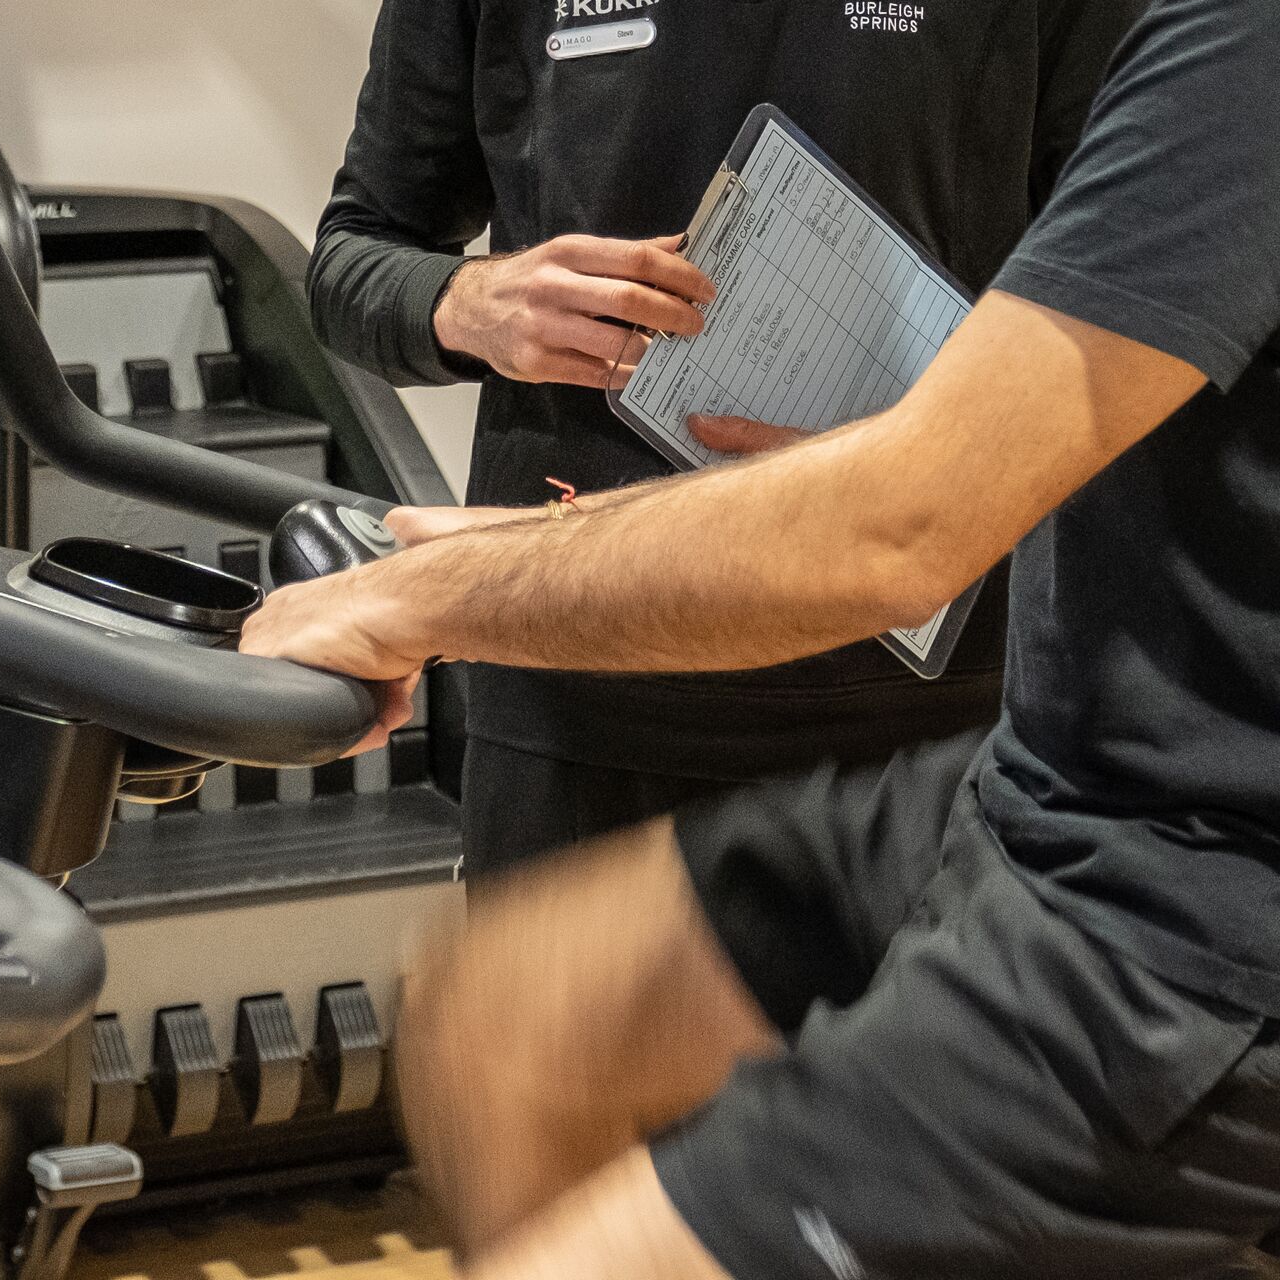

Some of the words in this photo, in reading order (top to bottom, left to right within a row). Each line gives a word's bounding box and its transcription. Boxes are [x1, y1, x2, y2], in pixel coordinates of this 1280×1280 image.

[844, 1, 924, 20] BURLEIGH
[850, 16, 918, 33] SPRINGS
[737, 211, 757, 240] CARD
[633, 371, 653, 401] Name:
